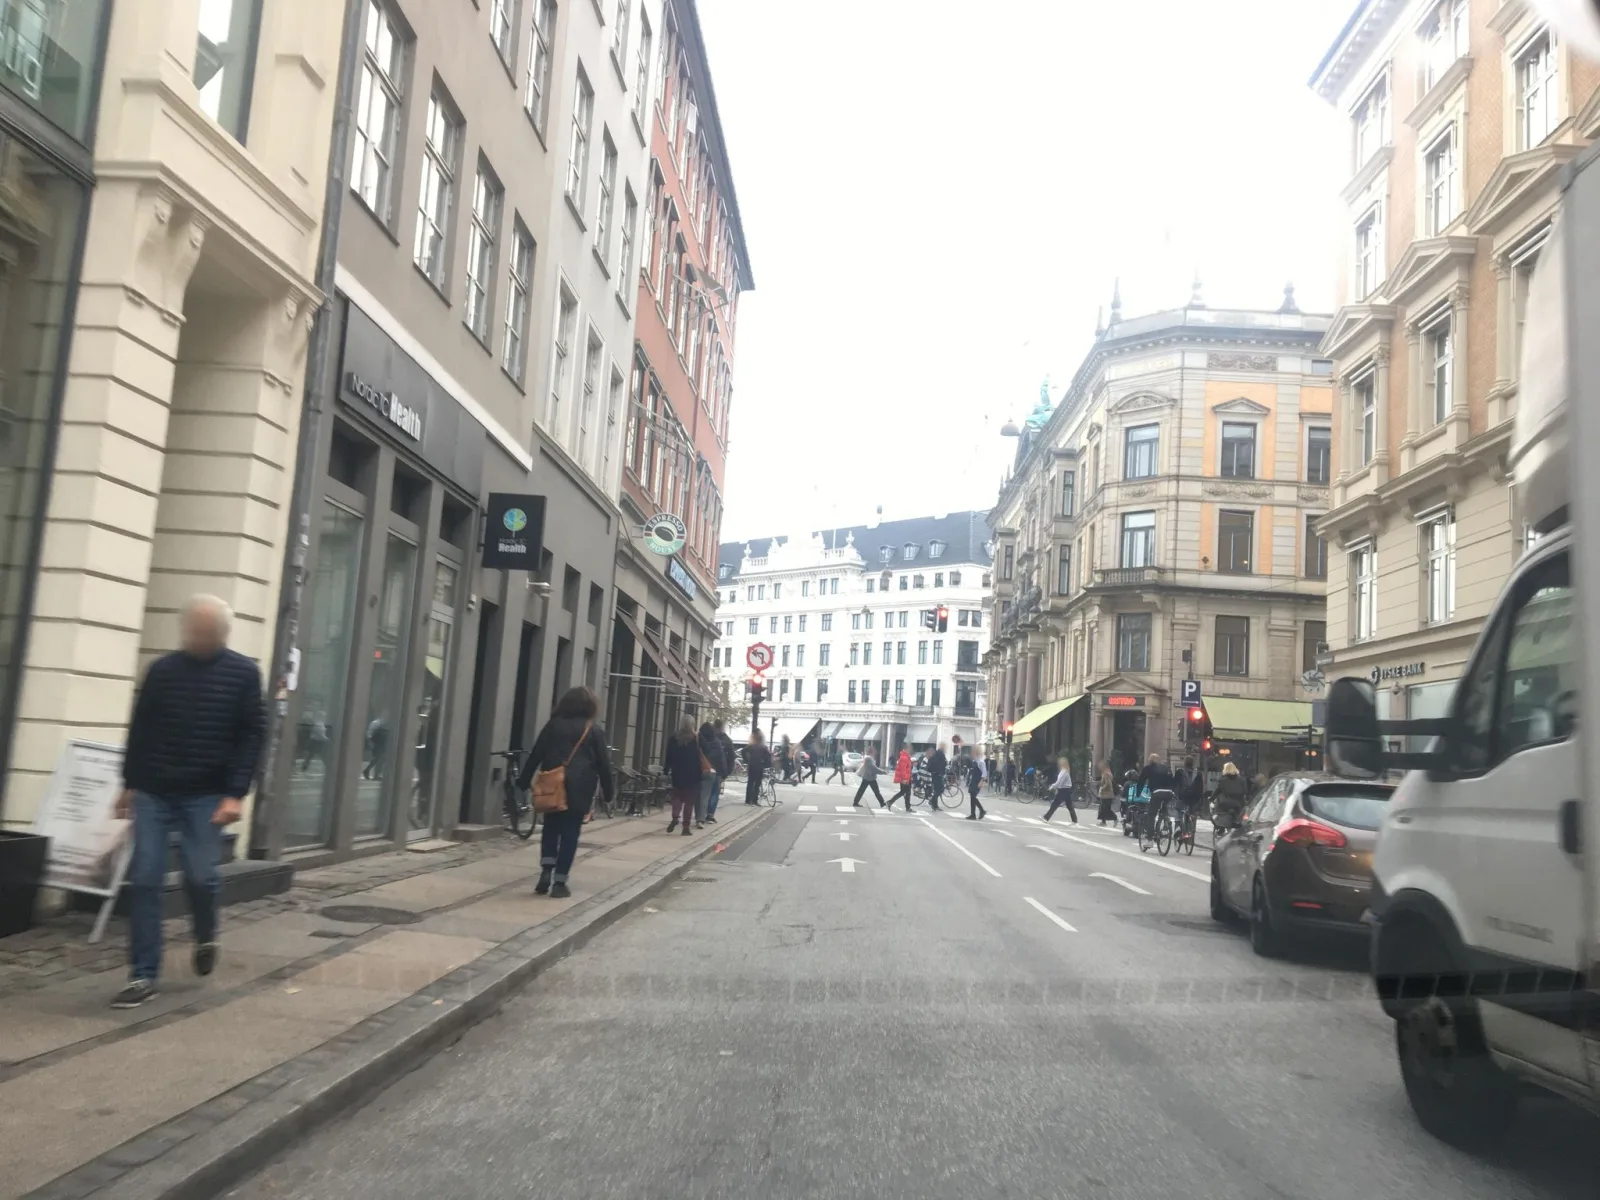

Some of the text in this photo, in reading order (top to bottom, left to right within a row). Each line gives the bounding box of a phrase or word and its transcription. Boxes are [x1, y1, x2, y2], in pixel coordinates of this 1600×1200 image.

[390, 392, 421, 442] Health
[647, 514, 684, 532] ESPRESSO
[498, 543, 527, 554] Health
[649, 541, 677, 554] HOUSE
[1380, 662, 1424, 680] JYSKE BANK
[1185, 681, 1197, 697] P
